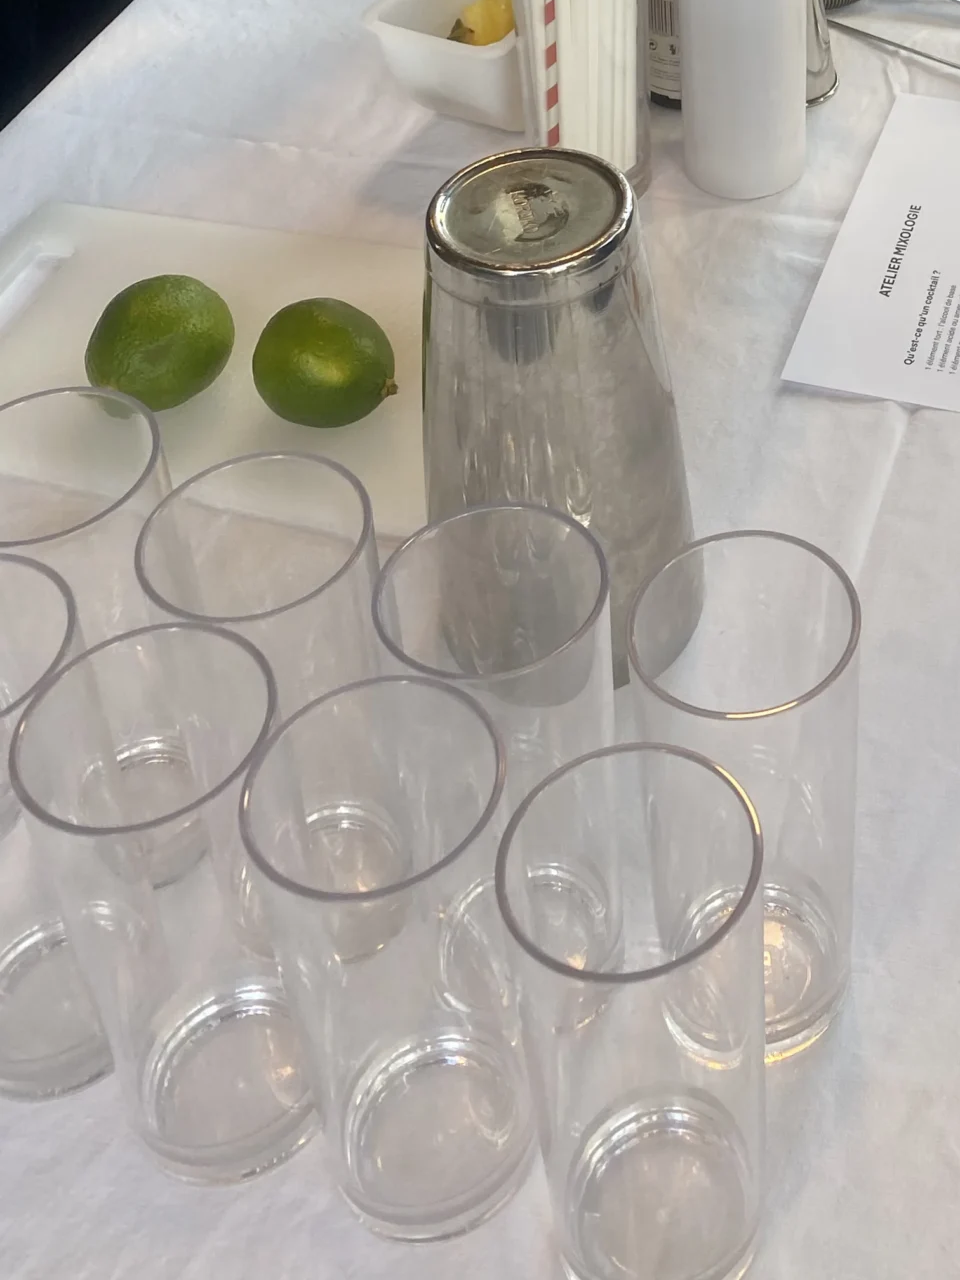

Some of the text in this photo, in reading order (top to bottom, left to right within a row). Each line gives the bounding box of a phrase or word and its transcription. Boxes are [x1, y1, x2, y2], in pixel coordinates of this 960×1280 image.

[879, 205, 922, 298] ATELIER MIXOLOGIE
[903, 328, 923, 366] Qu'est-ce
[917, 306, 930, 327] qu'un
[925, 276, 940, 305] cocktail
